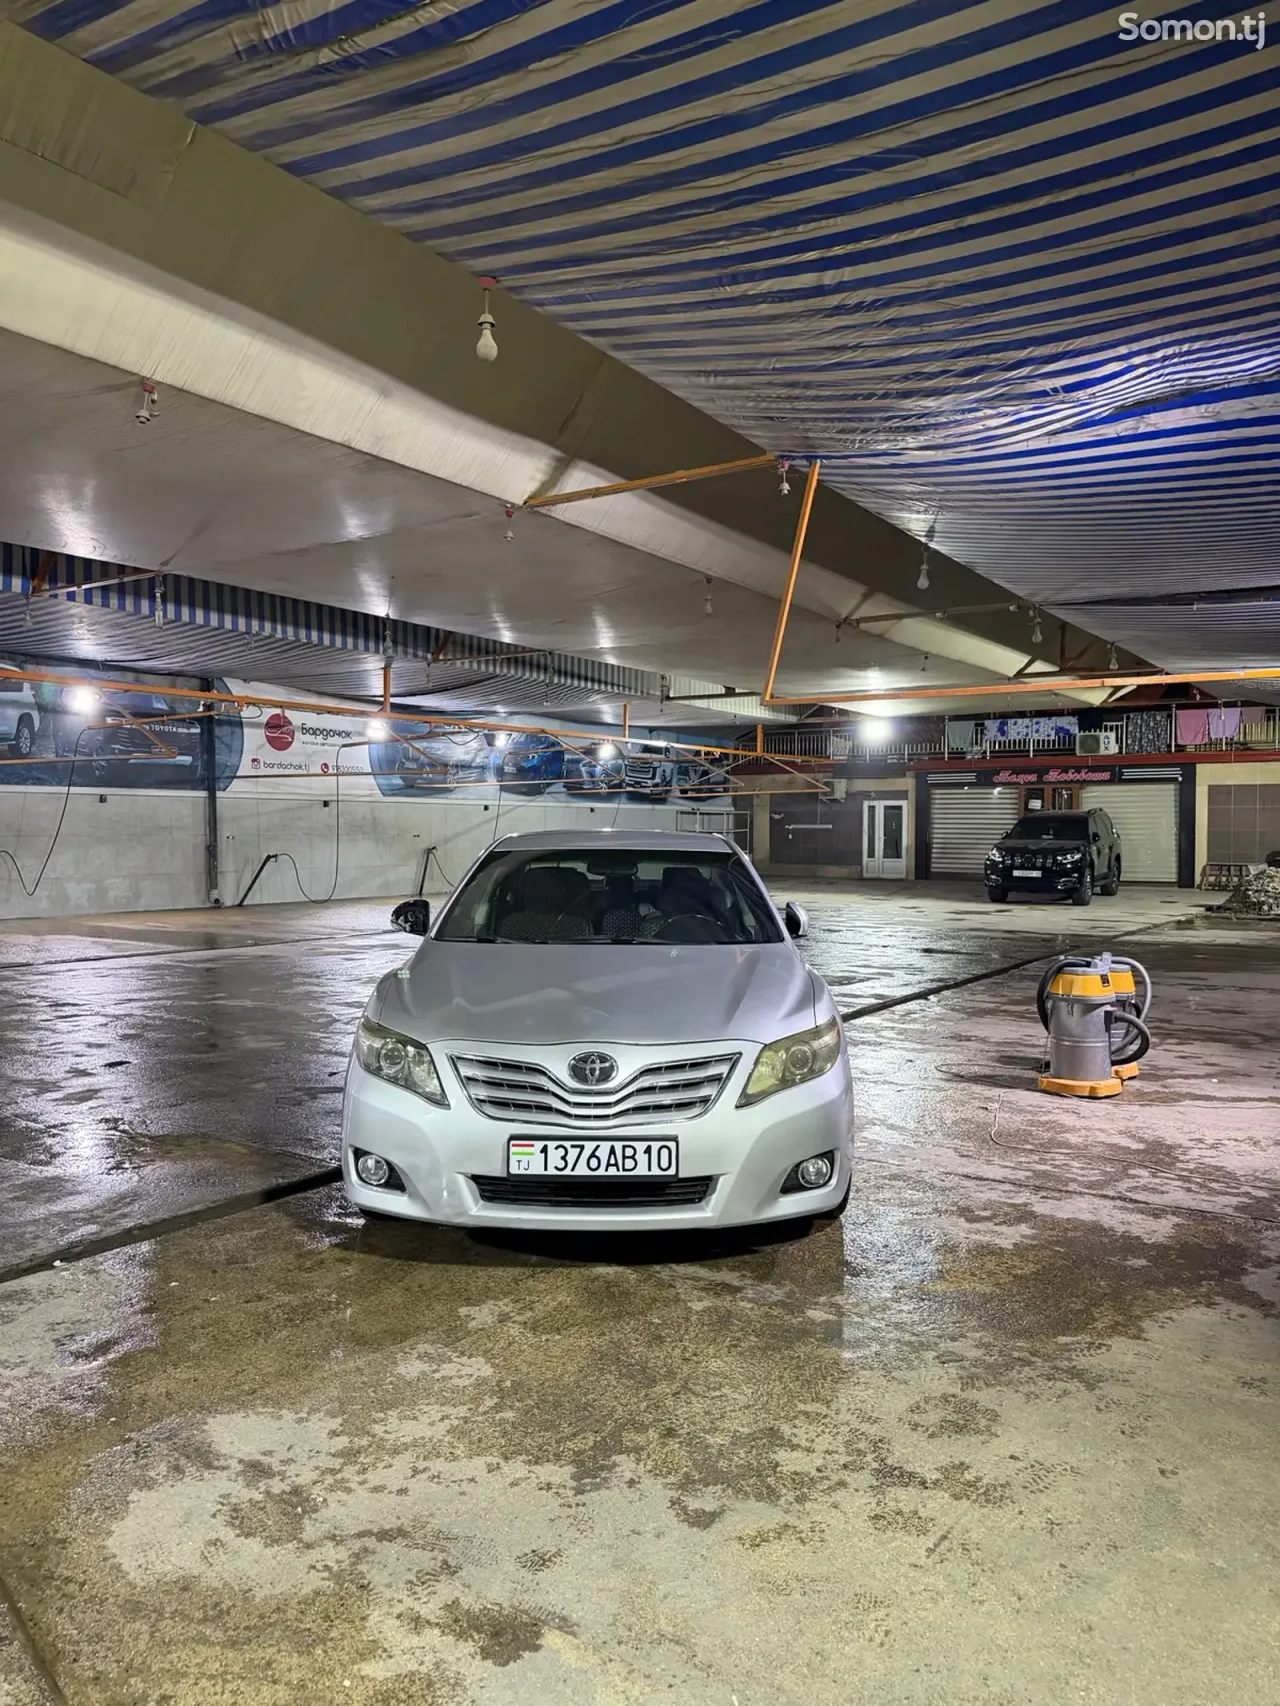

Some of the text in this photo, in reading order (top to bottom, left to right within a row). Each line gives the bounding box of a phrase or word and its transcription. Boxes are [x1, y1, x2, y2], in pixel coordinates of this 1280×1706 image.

[150, 724, 177, 732] TOYOTA
[539, 1143, 673, 1173] 1376AB10
[516, 1159, 530, 1171] TJ
